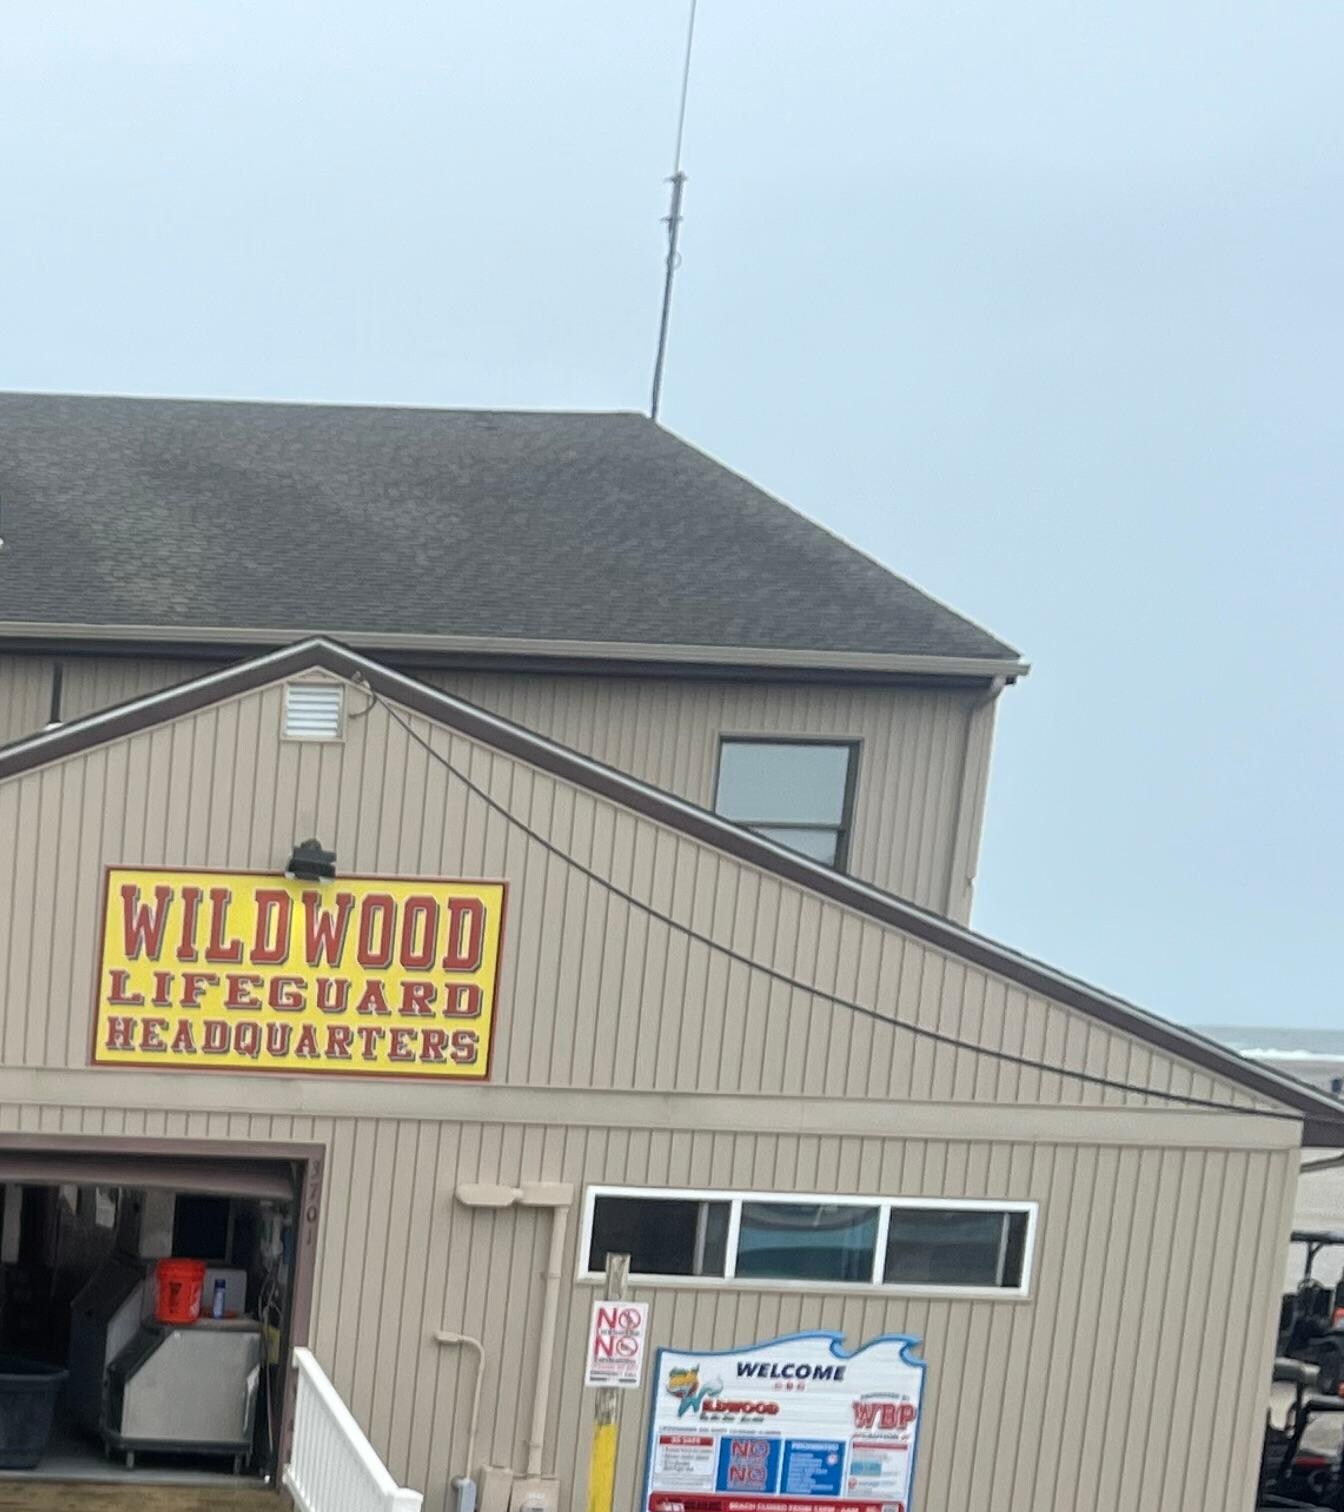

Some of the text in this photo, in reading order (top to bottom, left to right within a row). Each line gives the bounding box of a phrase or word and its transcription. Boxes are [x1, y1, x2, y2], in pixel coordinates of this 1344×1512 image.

[120, 883, 487, 972] WILDWOOD
[107, 969, 481, 1018] LIFEGUARD
[105, 1016, 479, 1064] HEADQUARTERS
[736, 1361, 847, 1382] WELCOME
[853, 1402, 917, 1430] WBP
